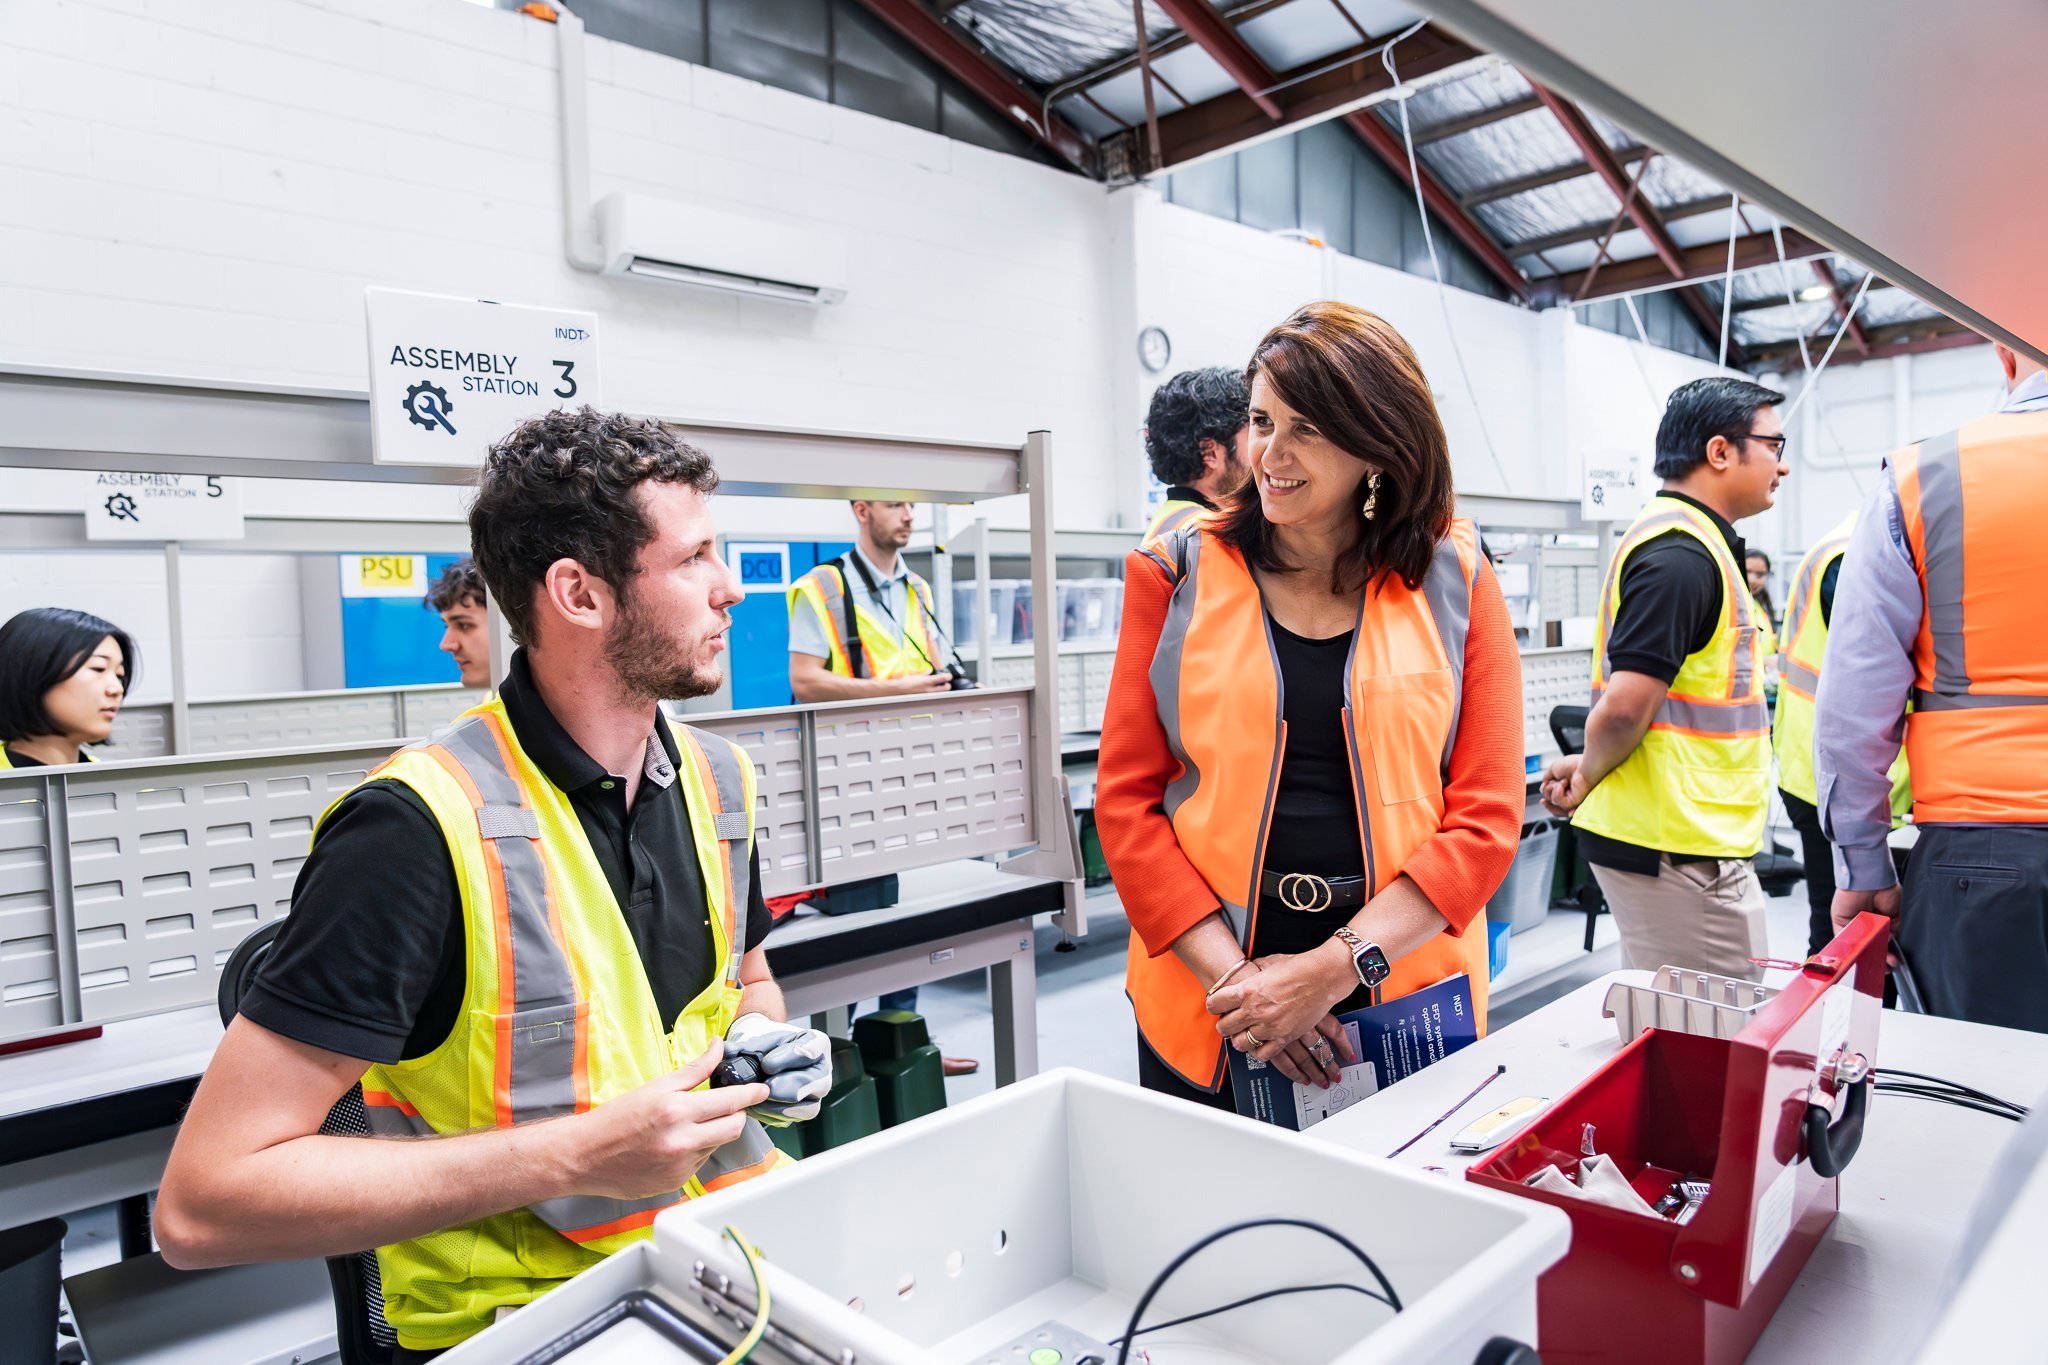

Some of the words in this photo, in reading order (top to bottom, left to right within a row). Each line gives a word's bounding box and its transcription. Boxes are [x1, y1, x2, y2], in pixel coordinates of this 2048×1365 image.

[555, 328, 584, 340] INDT
[390, 345, 518, 375] ASSEMBLY
[463, 376, 538, 396] STATION
[552, 360, 578, 398] 3
[98, 473, 182, 486] ASSEMBLY
[144, 488, 196, 498] STATION
[207, 476, 222, 498] 5
[362, 556, 412, 580] PSU
[741, 559, 782, 579] DCU
[1453, 994, 1464, 1016] INDT
[1422, 1007, 1432, 1042] optional
[1428, 1043, 1438, 1064] ancil
[1434, 1025, 1445, 1058] systems
